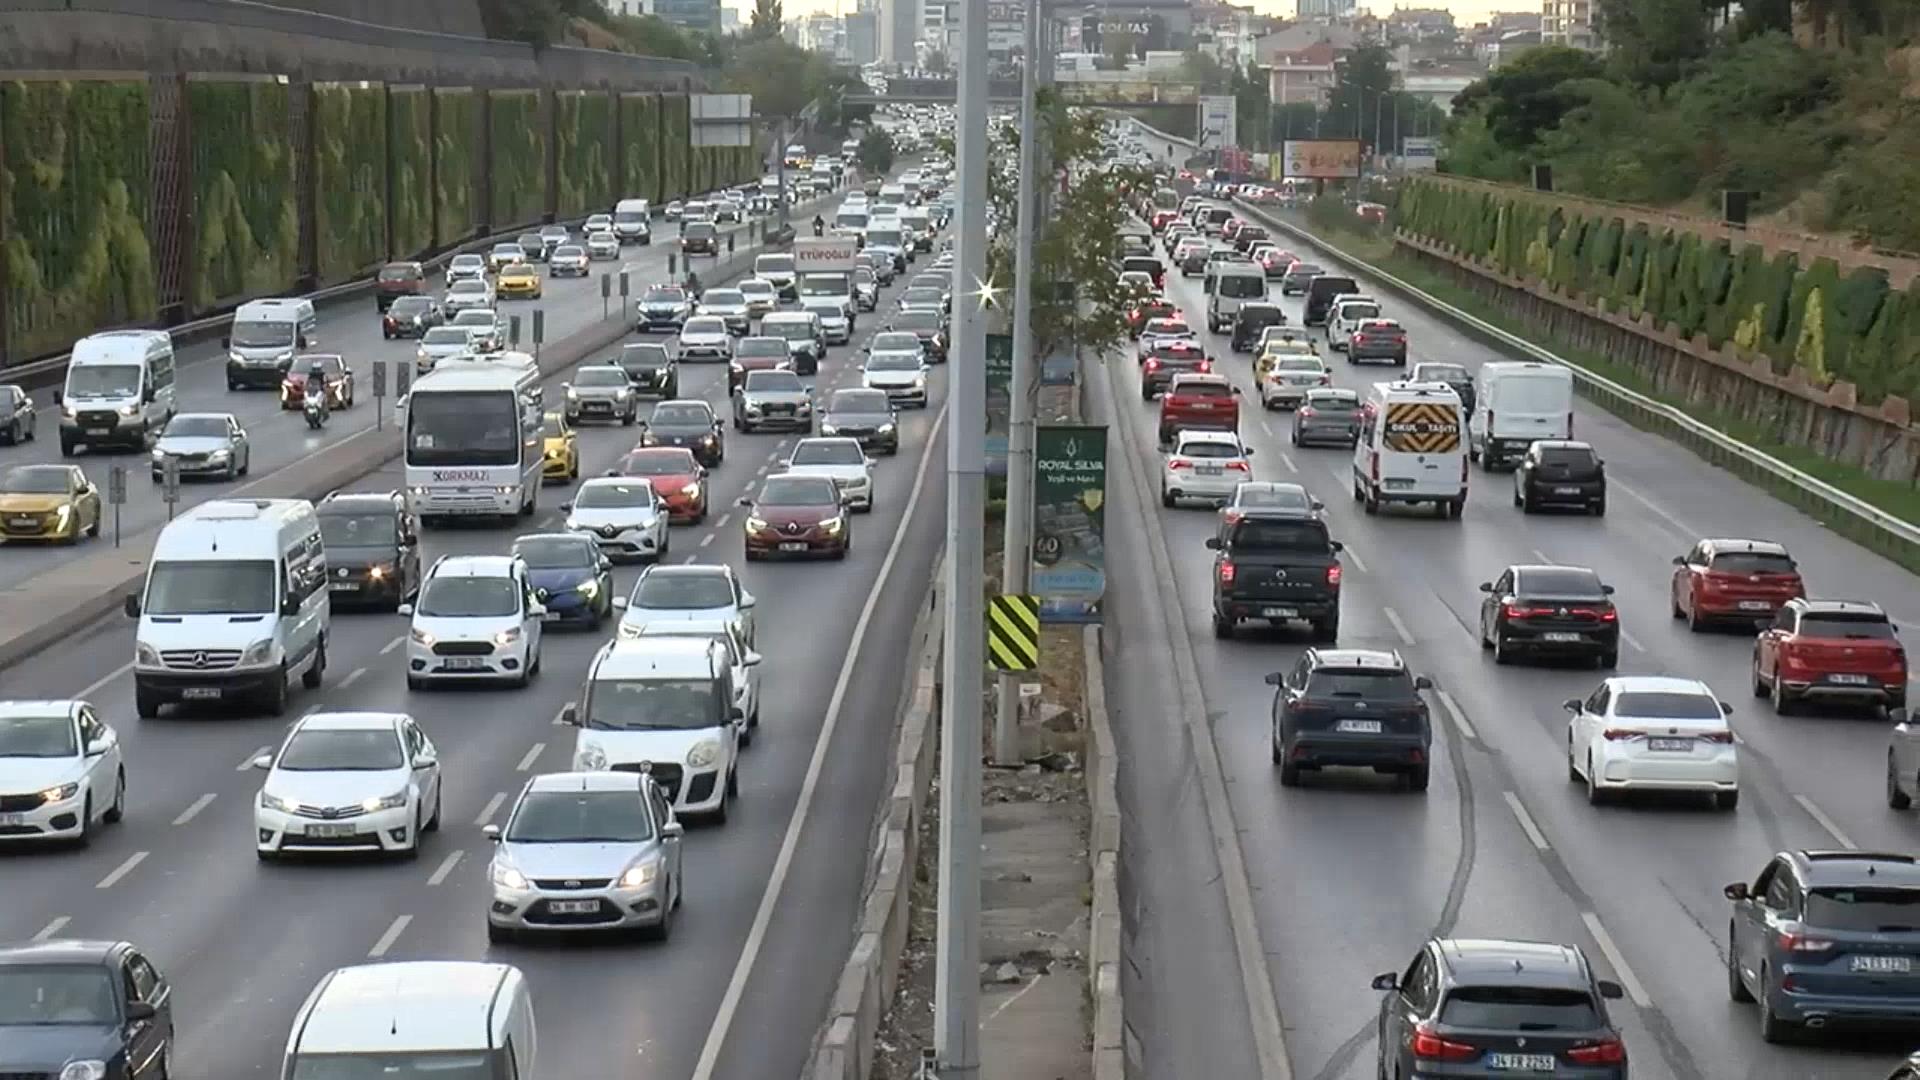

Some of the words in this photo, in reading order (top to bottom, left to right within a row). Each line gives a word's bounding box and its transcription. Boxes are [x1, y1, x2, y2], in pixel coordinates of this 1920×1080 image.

[1391, 424, 1417, 433] OKUL
[1038, 460, 1073, 471] ROYAL
[1037, 537, 1058, 553] 60
